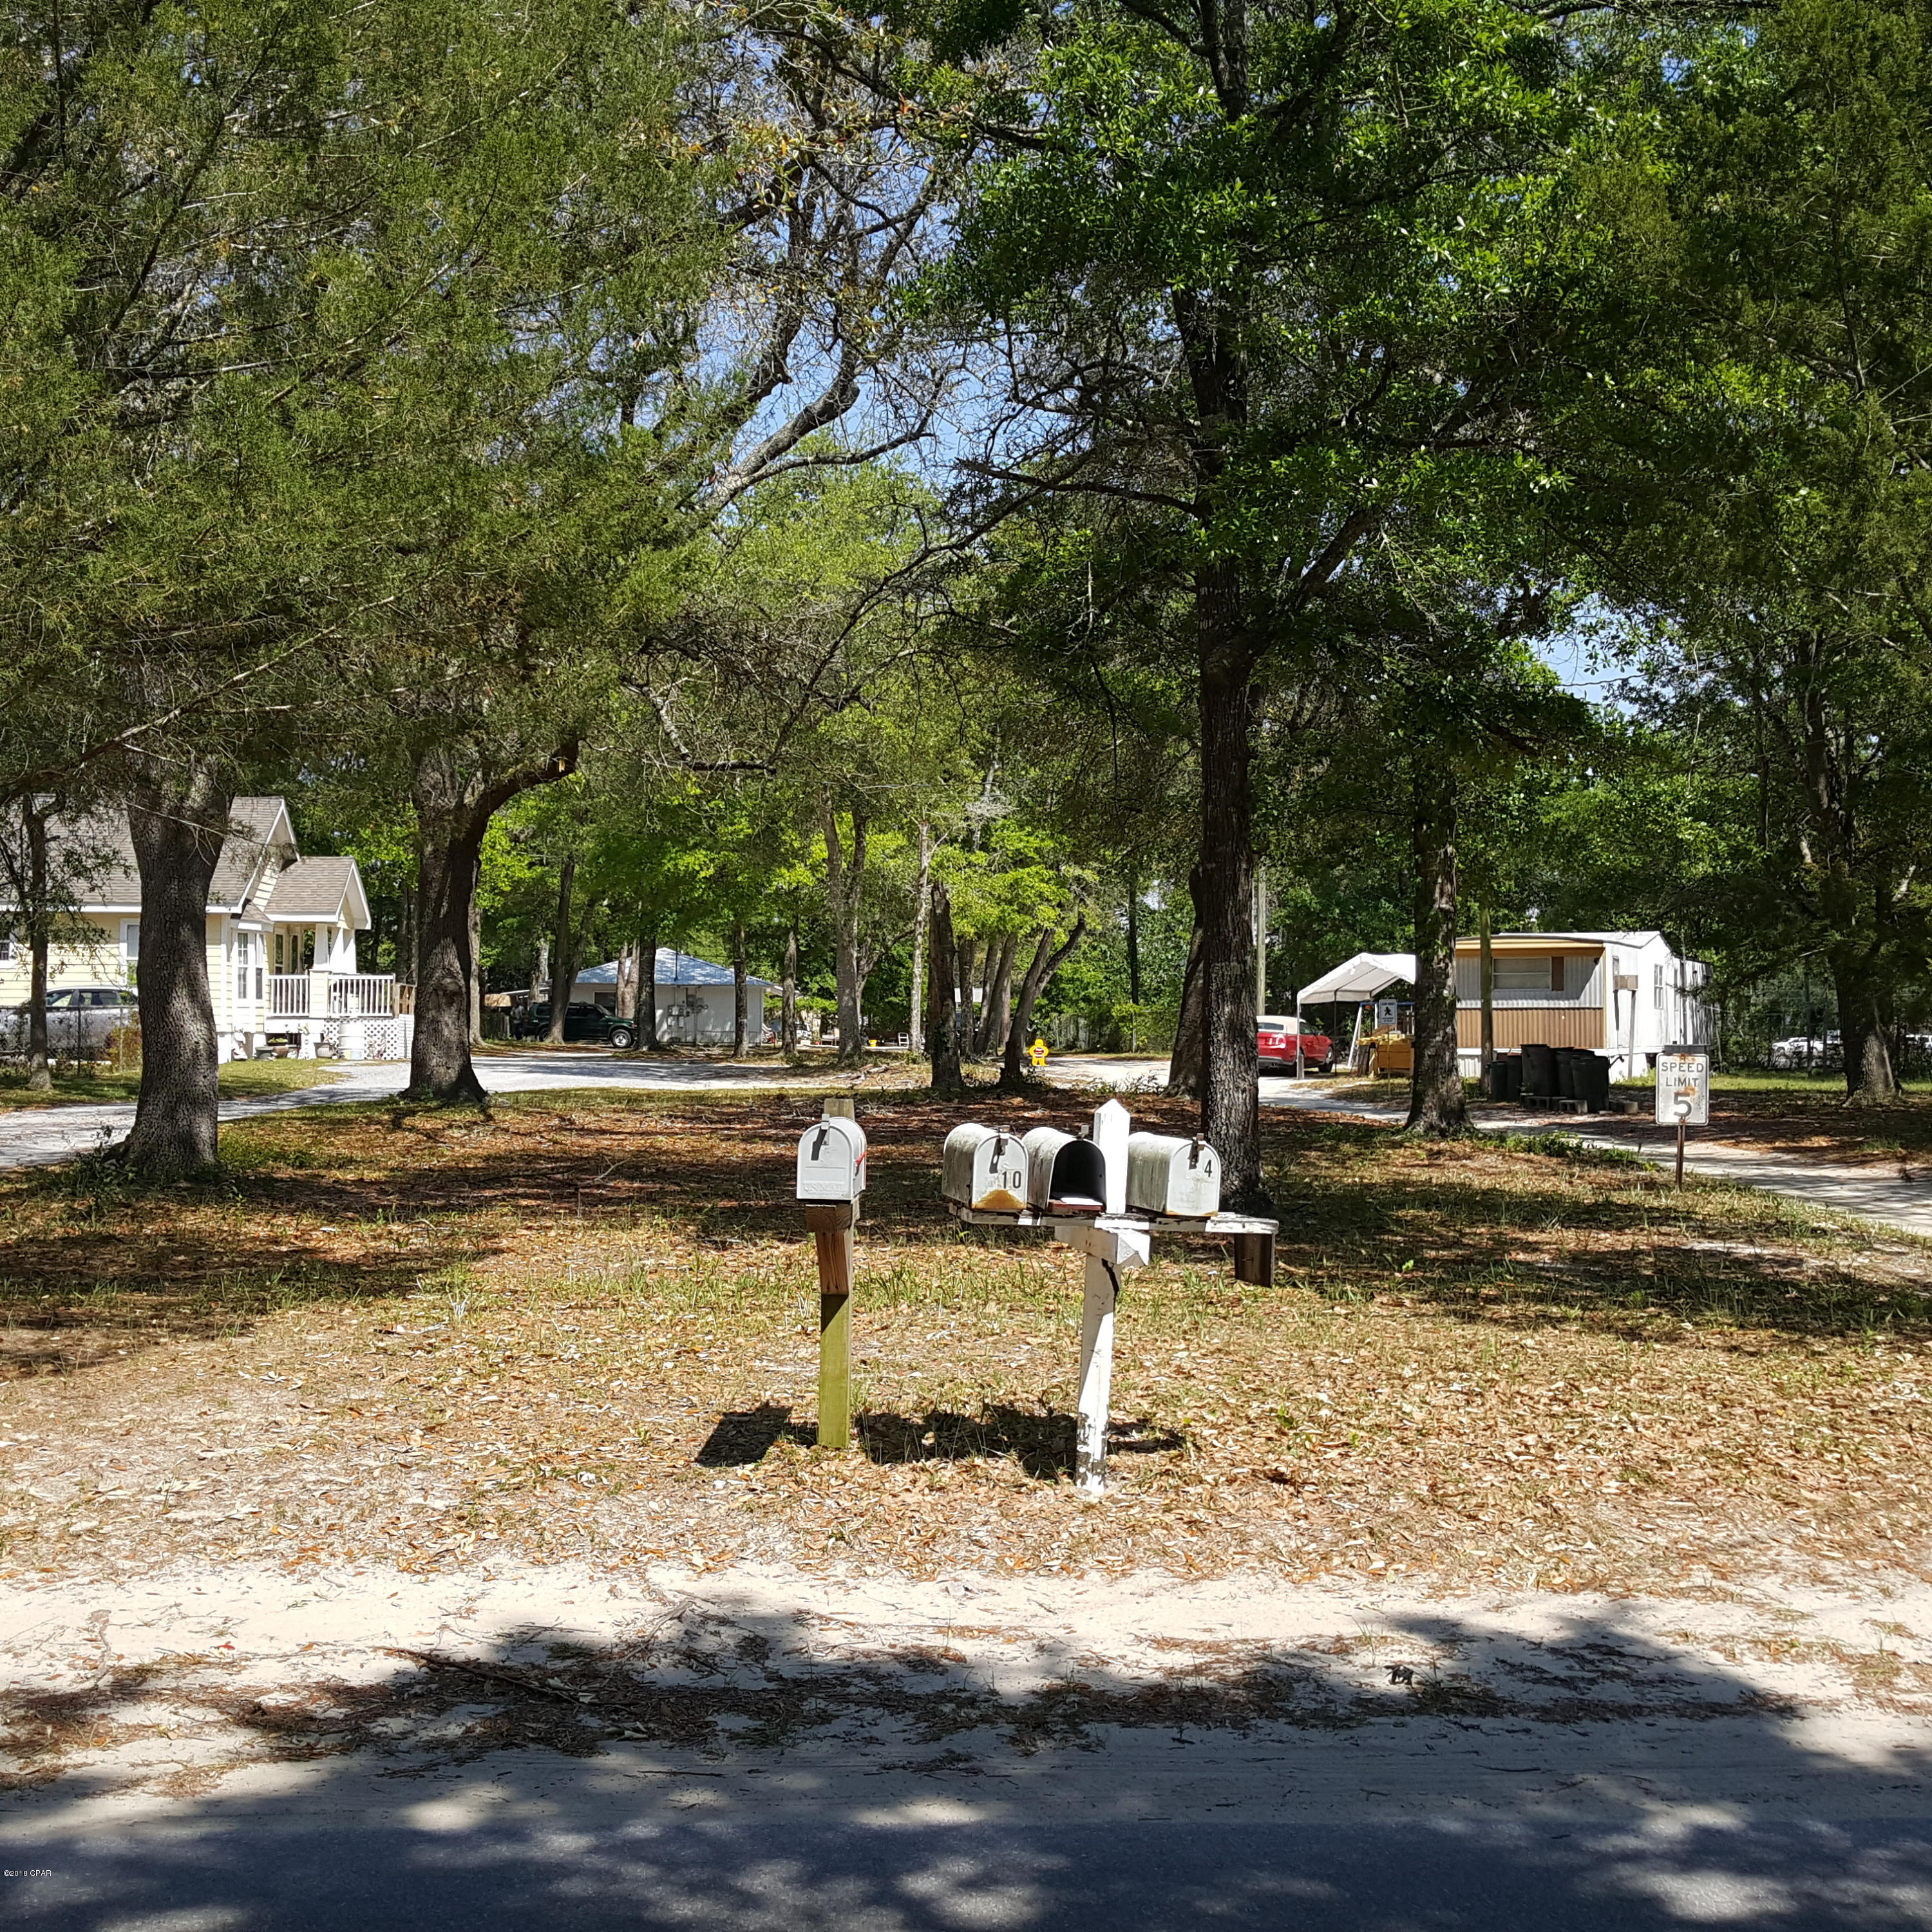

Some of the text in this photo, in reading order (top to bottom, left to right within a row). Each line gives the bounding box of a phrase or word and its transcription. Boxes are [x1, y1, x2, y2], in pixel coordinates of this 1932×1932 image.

[1661, 1062, 1704, 1072] SPEED
[1665, 1076, 1700, 1087] LIMIT
[1673, 1092, 1692, 1117] 5
[1204, 1159, 1213, 1178] 4
[1001, 1170, 1022, 1189] 10
